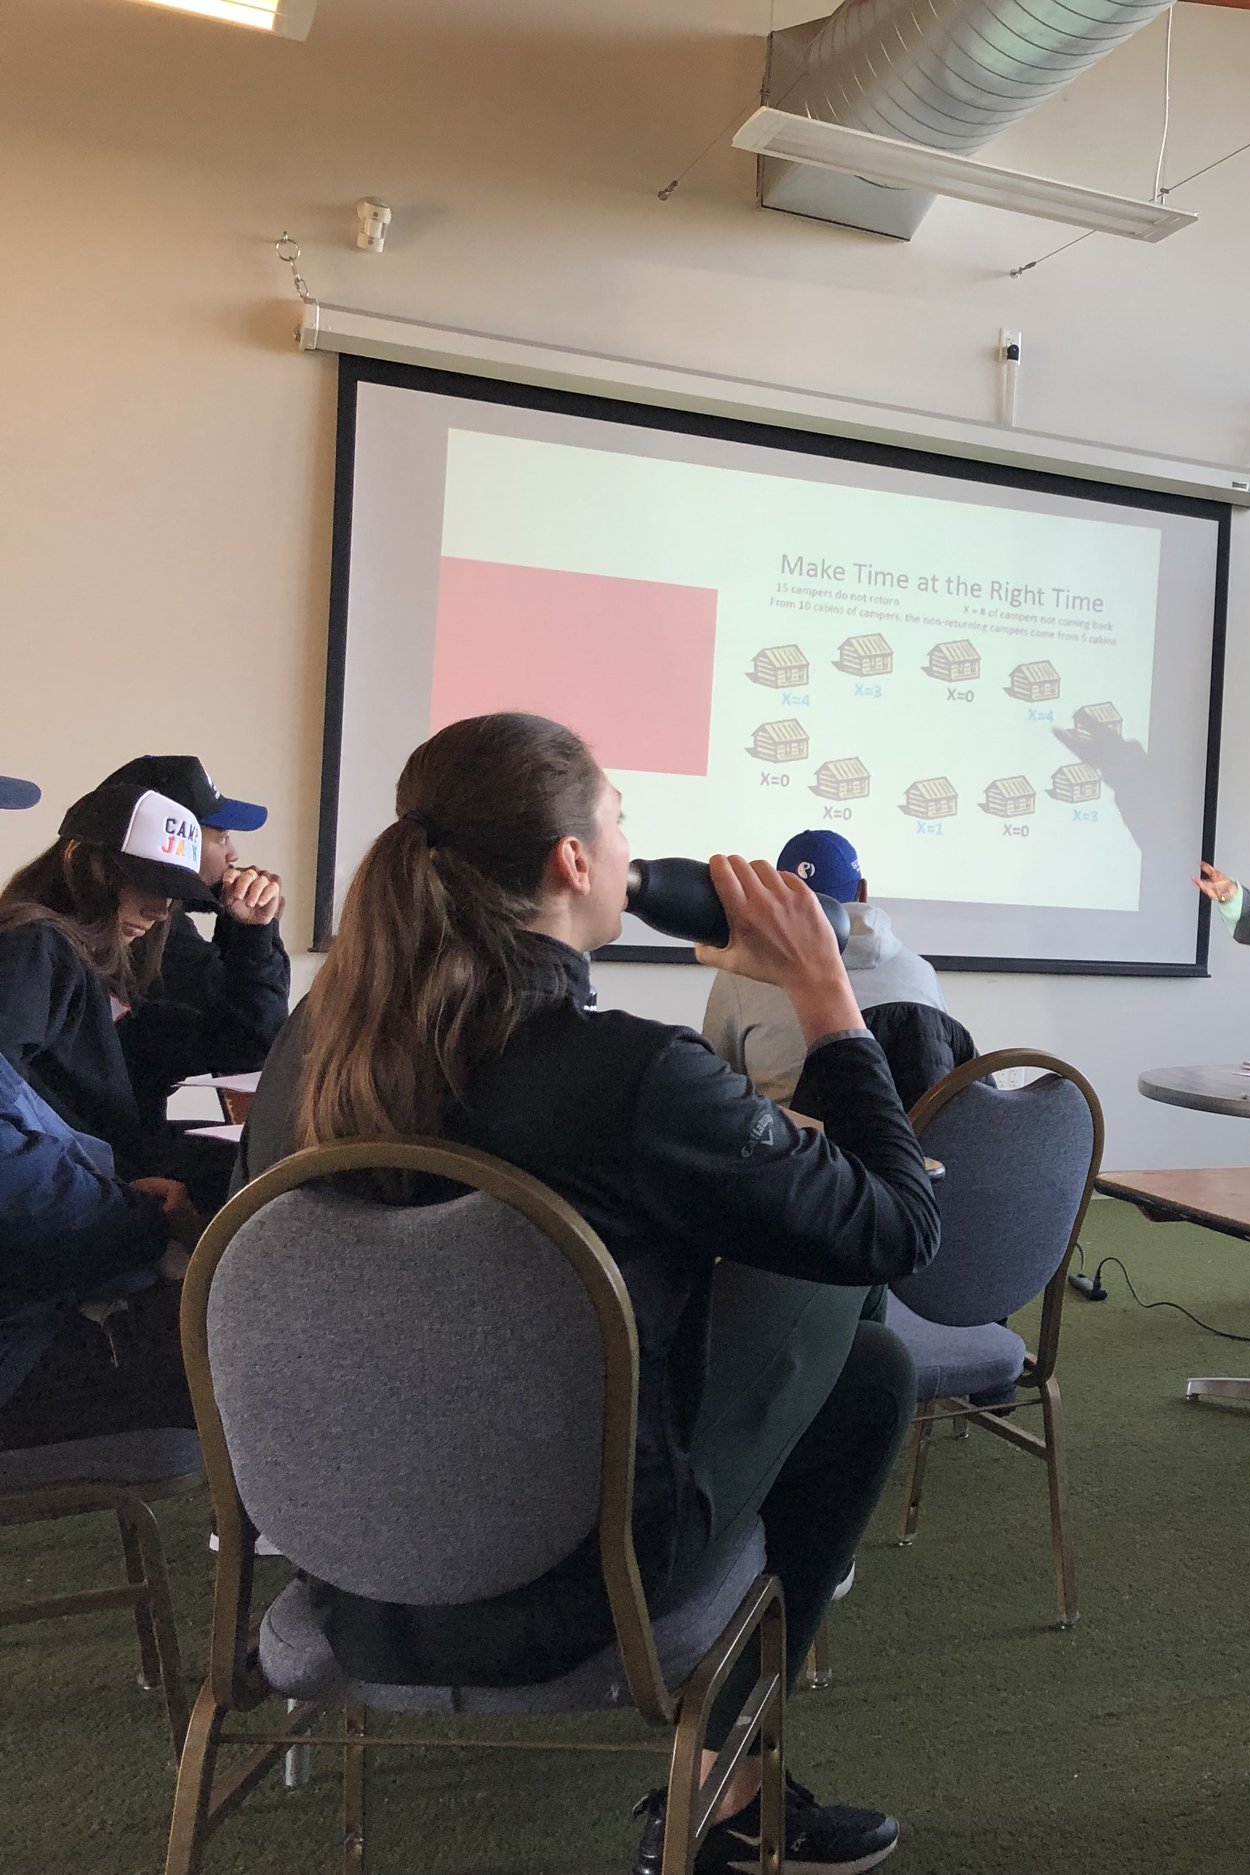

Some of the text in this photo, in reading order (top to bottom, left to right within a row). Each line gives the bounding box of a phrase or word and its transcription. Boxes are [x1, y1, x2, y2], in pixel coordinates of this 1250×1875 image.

[780, 553, 1104, 613] Make Time at the Right Time
[776, 582, 900, 606] 15 campers do not return
[769, 596, 796, 609] From
[799, 600, 812, 611] 10
[813, 603, 844, 615] cabins
[846, 605, 858, 616] of
[905, 613, 921, 624] the
[923, 616, 988, 633] non-returning
[990, 624, 1028, 637] campers
[1030, 628, 1055, 639] come
[1057, 630, 1079, 642] from
[1088, 634, 1117, 646] cabins
[988, 609, 998, 618] of
[1000, 611, 1038, 623] campers
[1040, 615, 1056, 625] not
[1058, 618, 1090, 631] coming
[1092, 619, 1113, 631] back
[853, 682, 883, 698] X=3
[946, 687, 975, 703] X=0
[781, 692, 811, 707] X=4
[1027, 708, 1054, 723] X=4
[759, 771, 790, 788] X=0
[822, 805, 852, 821] X=0
[1072, 809, 1099, 823] X=3
[916, 821, 944, 836] X=1
[1002, 823, 1030, 838] X=0
